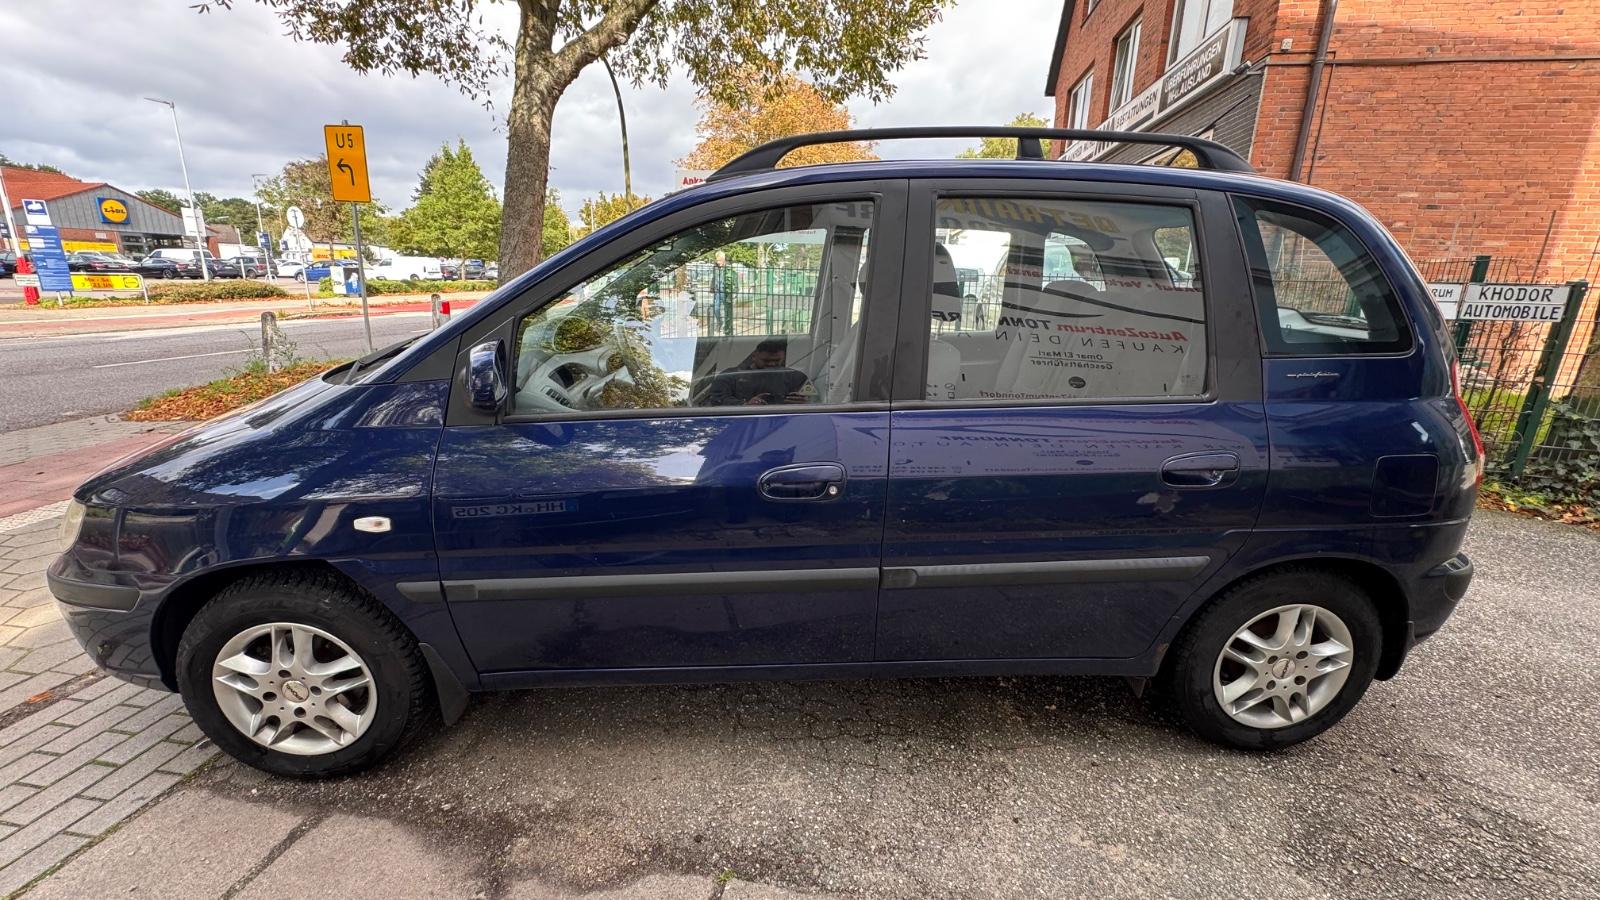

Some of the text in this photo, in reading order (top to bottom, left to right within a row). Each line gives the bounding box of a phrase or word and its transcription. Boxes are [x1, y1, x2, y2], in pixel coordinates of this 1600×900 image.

[682, 176, 704, 185] Anka
[103, 206, 126, 214] LIDL
[1432, 288, 1453, 298] RUM
[1478, 286, 1554, 302] KHODOR
[1463, 303, 1562, 320] AUTOMOBILE
